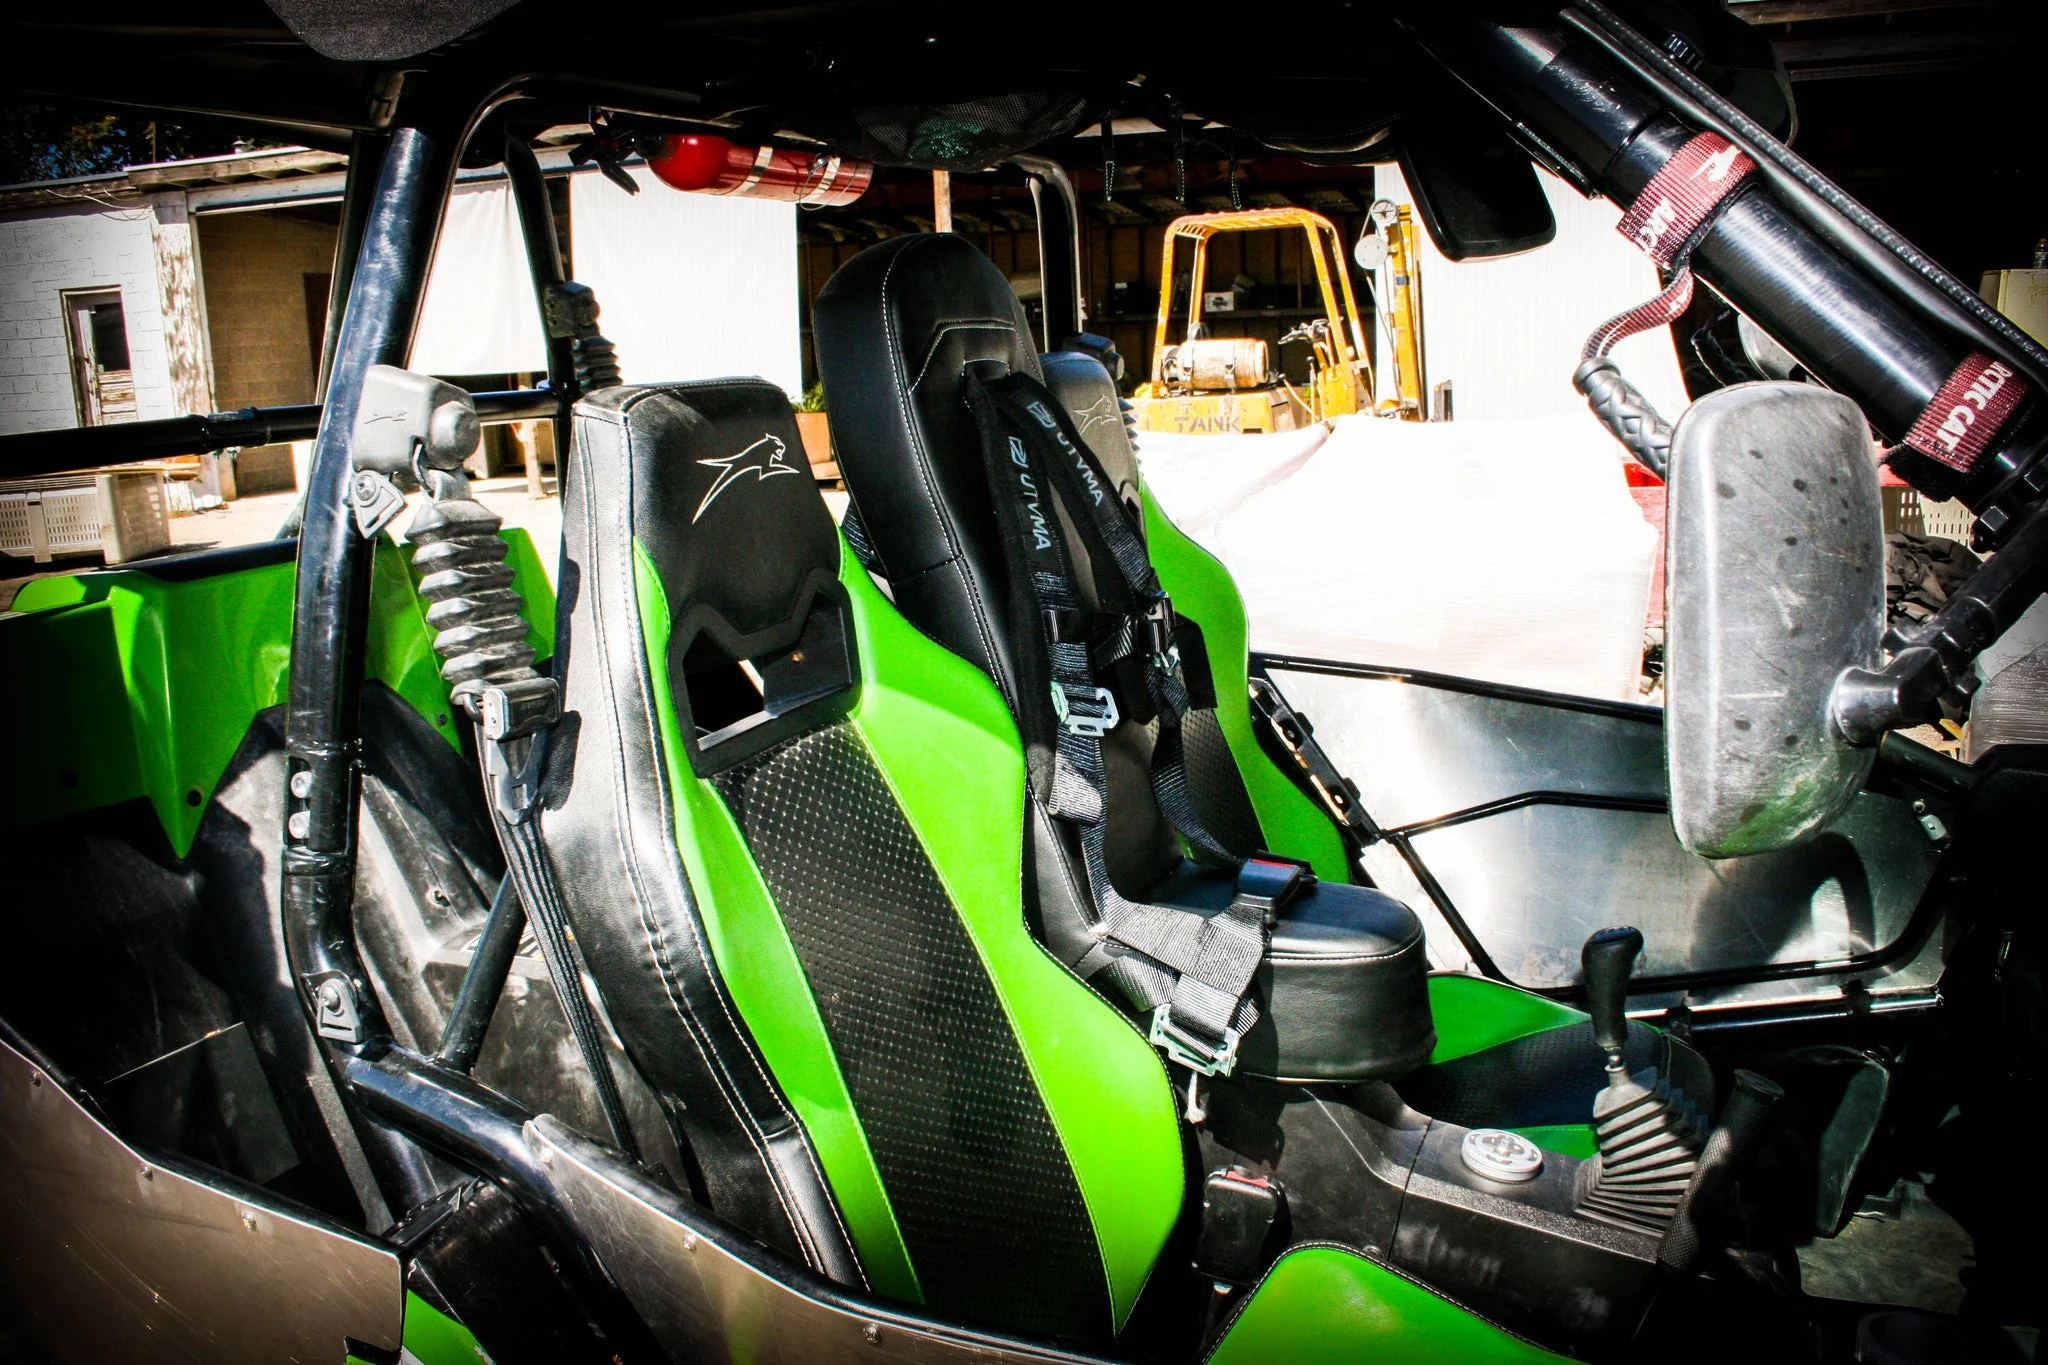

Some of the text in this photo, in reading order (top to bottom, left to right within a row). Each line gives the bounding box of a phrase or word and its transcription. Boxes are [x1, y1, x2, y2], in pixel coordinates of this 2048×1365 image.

[1174, 416, 1240, 433] TANK
[1936, 361, 2013, 452] RCTIC CAT
[1056, 432, 1104, 506] UTVMA
[1020, 473, 1052, 550] UTVMA
